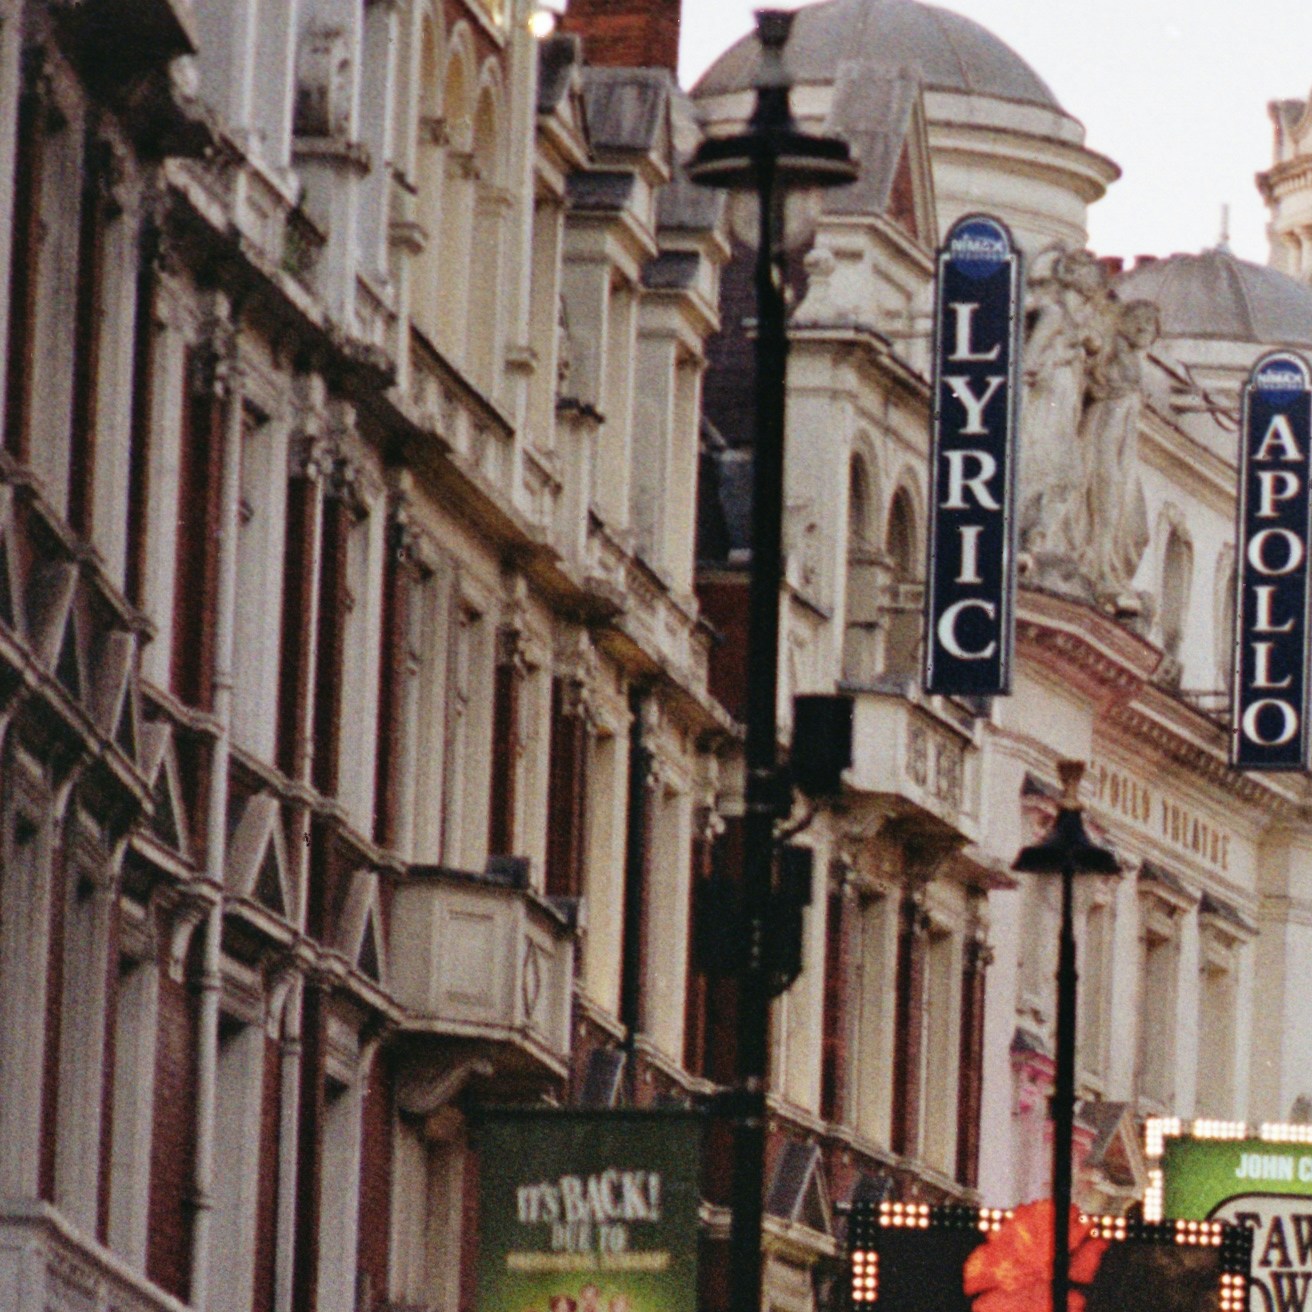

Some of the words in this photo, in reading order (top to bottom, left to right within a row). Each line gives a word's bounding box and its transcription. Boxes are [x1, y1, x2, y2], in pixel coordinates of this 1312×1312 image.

[937, 303, 1001, 660] LYRIC
[1243, 414, 1302, 745] APOLLO
[560, 1168, 661, 1222] BACK!
[1236, 1154, 1293, 1181] JOHN
